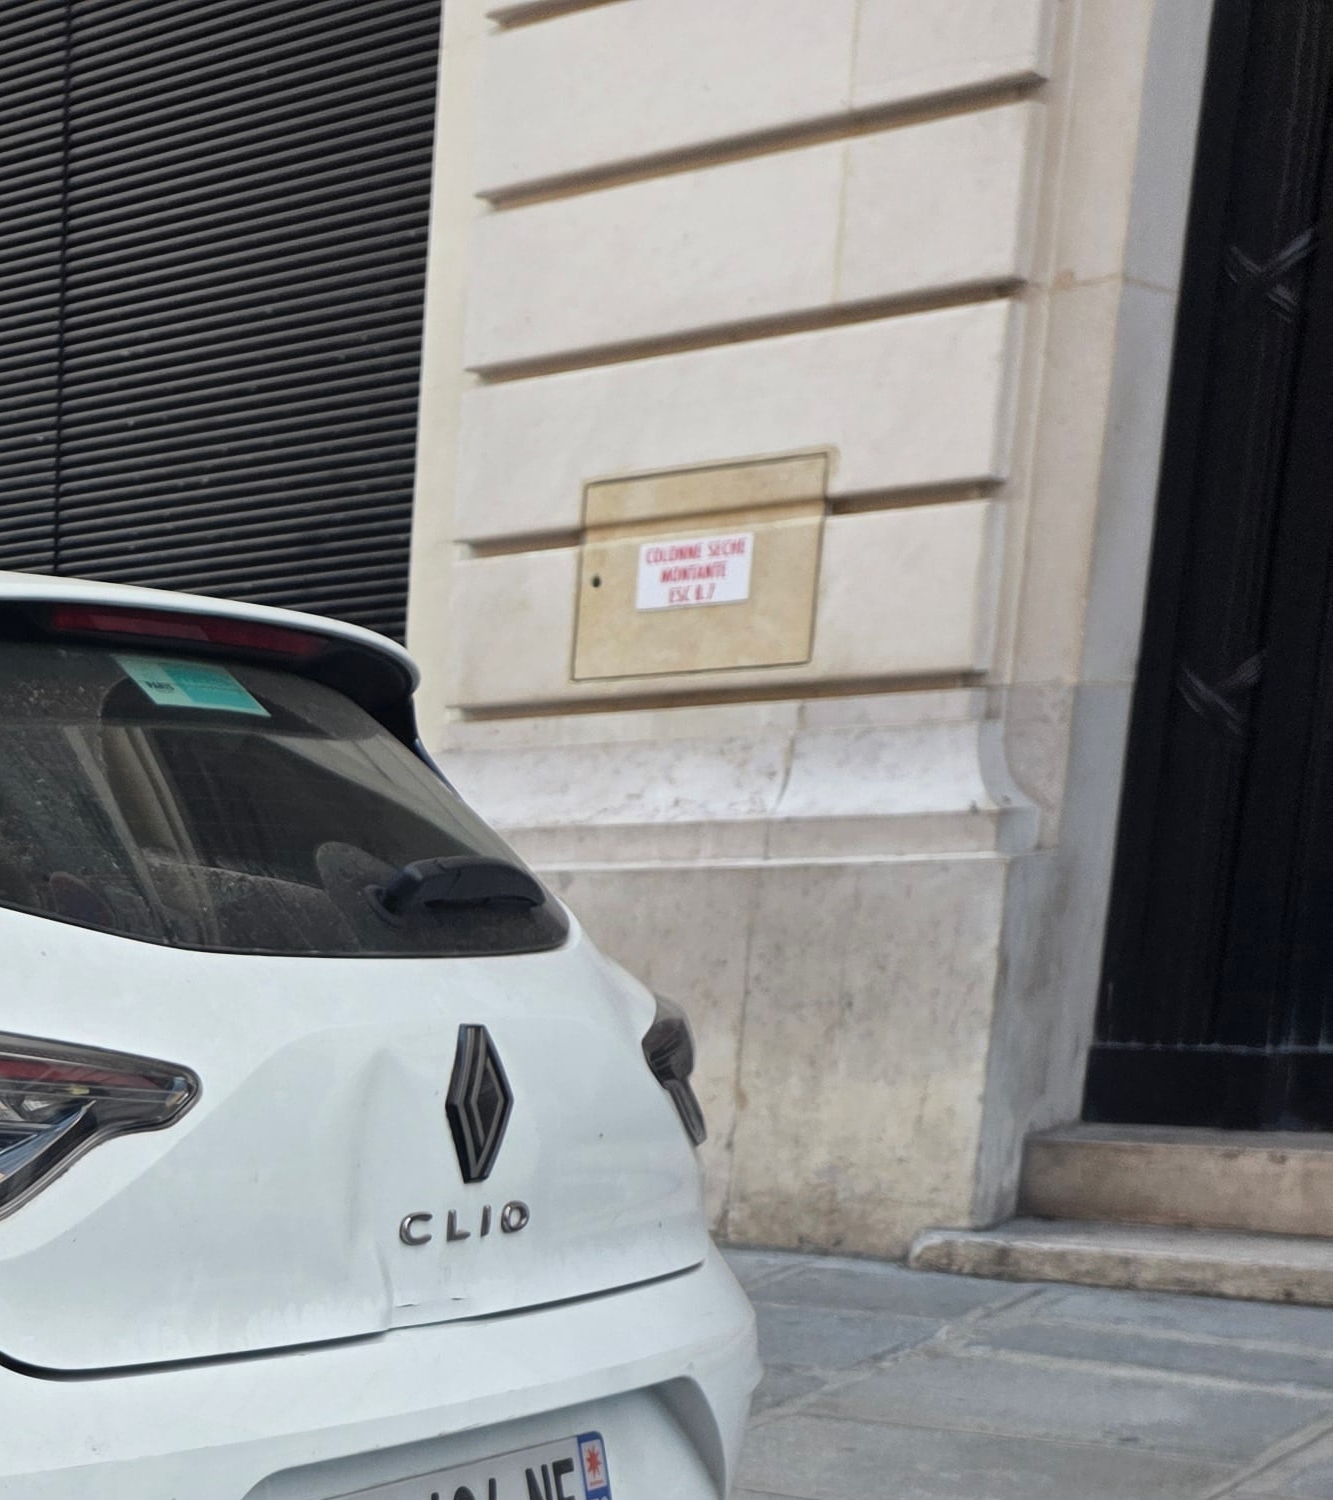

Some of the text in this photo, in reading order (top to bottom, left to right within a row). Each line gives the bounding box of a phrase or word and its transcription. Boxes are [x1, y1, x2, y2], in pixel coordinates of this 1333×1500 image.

[645, 538, 747, 565] COLONNE SECHE
[660, 561, 727, 583] MONTANTE
[668, 586, 691, 604] ESC
[399, 1200, 531, 1246] CLIO
